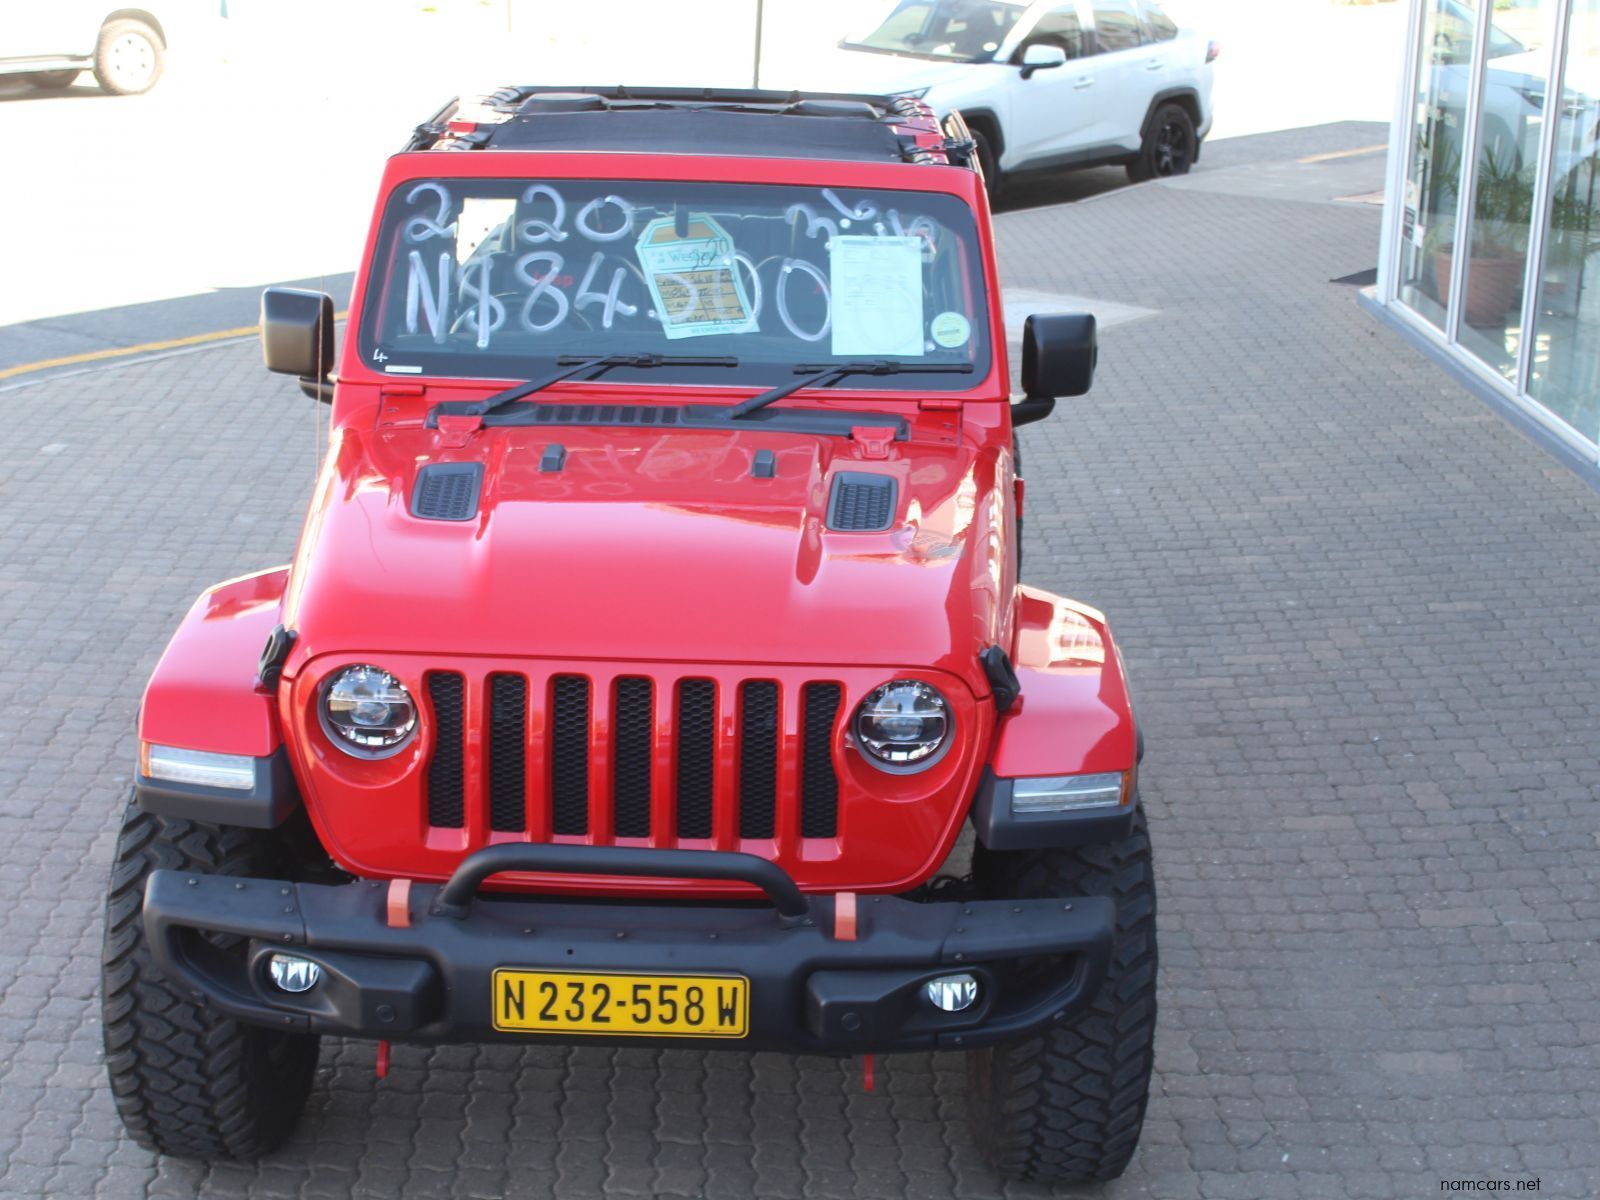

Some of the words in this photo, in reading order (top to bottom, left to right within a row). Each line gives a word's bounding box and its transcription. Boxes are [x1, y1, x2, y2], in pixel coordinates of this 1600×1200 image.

[503, 979, 525, 1021] N
[538, 981, 705, 1027] 232-558
[717, 986, 738, 1027] W
